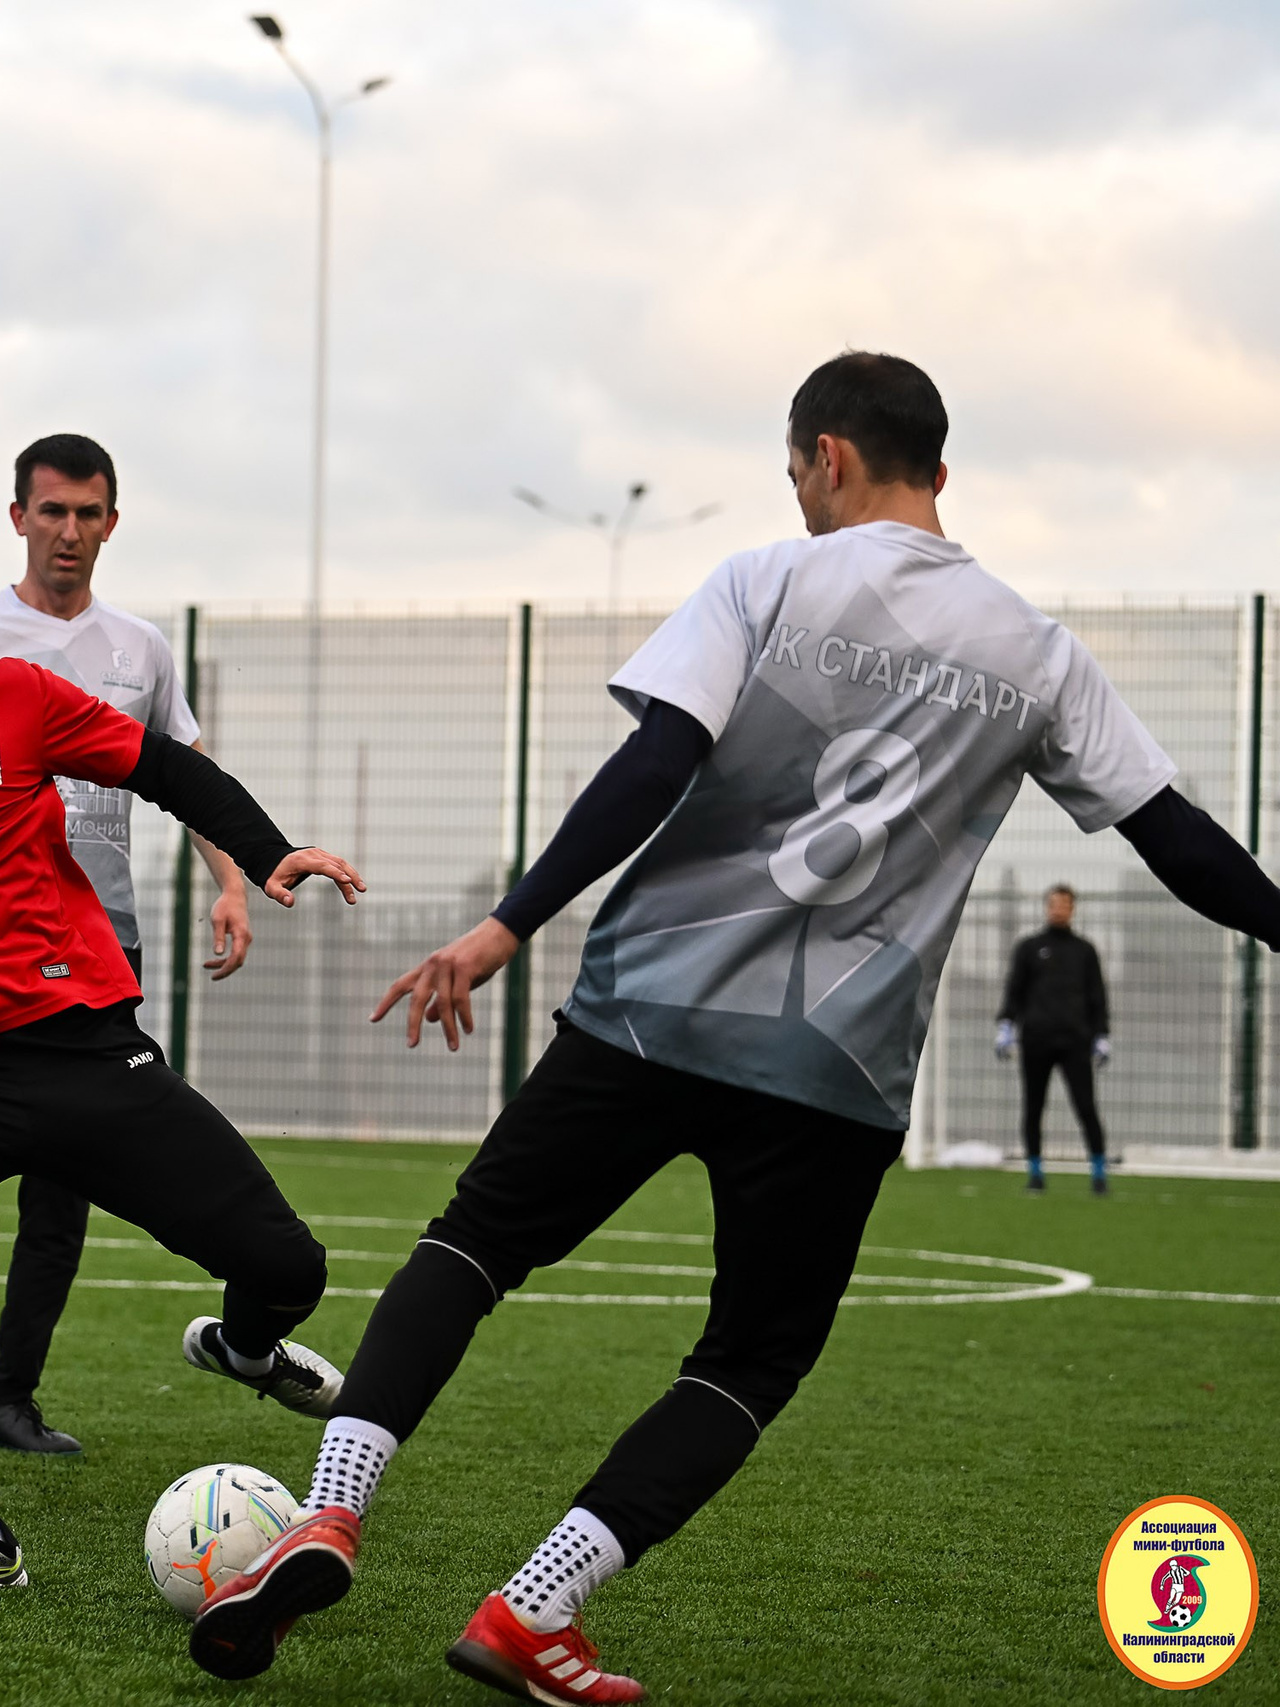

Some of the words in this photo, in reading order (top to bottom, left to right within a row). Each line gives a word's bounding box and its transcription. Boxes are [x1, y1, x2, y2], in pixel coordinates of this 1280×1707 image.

[816, 635, 1039, 731] СТАНДАРТ
[767, 728, 920, 907] 8
[126, 1051, 154, 1069] JAKO
